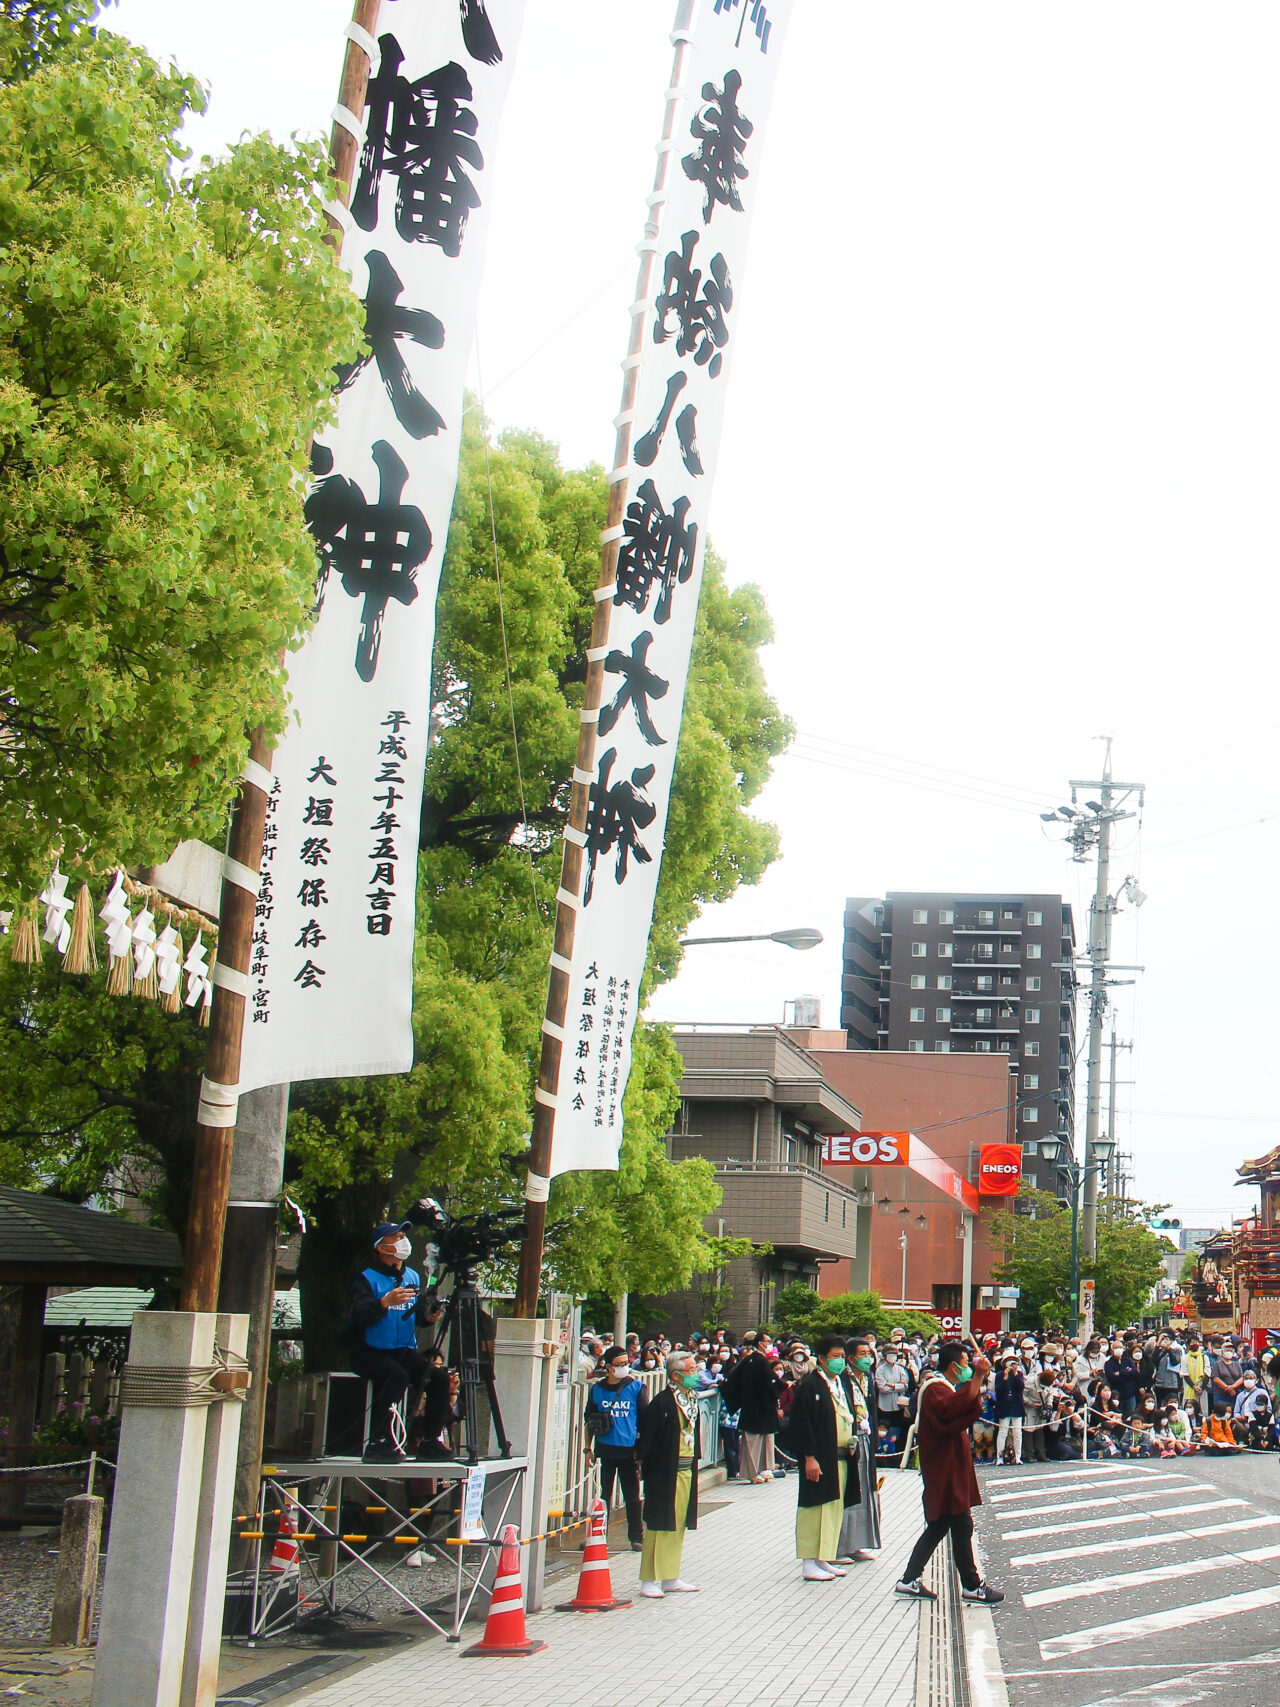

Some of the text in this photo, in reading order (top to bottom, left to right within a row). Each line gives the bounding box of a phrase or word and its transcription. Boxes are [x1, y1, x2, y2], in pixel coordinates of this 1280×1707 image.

[292, 755, 338, 990] 大垣祭保存会
[364, 709, 412, 938] 平成三十年五月吉日
[982, 1164, 1019, 1174] ENEOS
